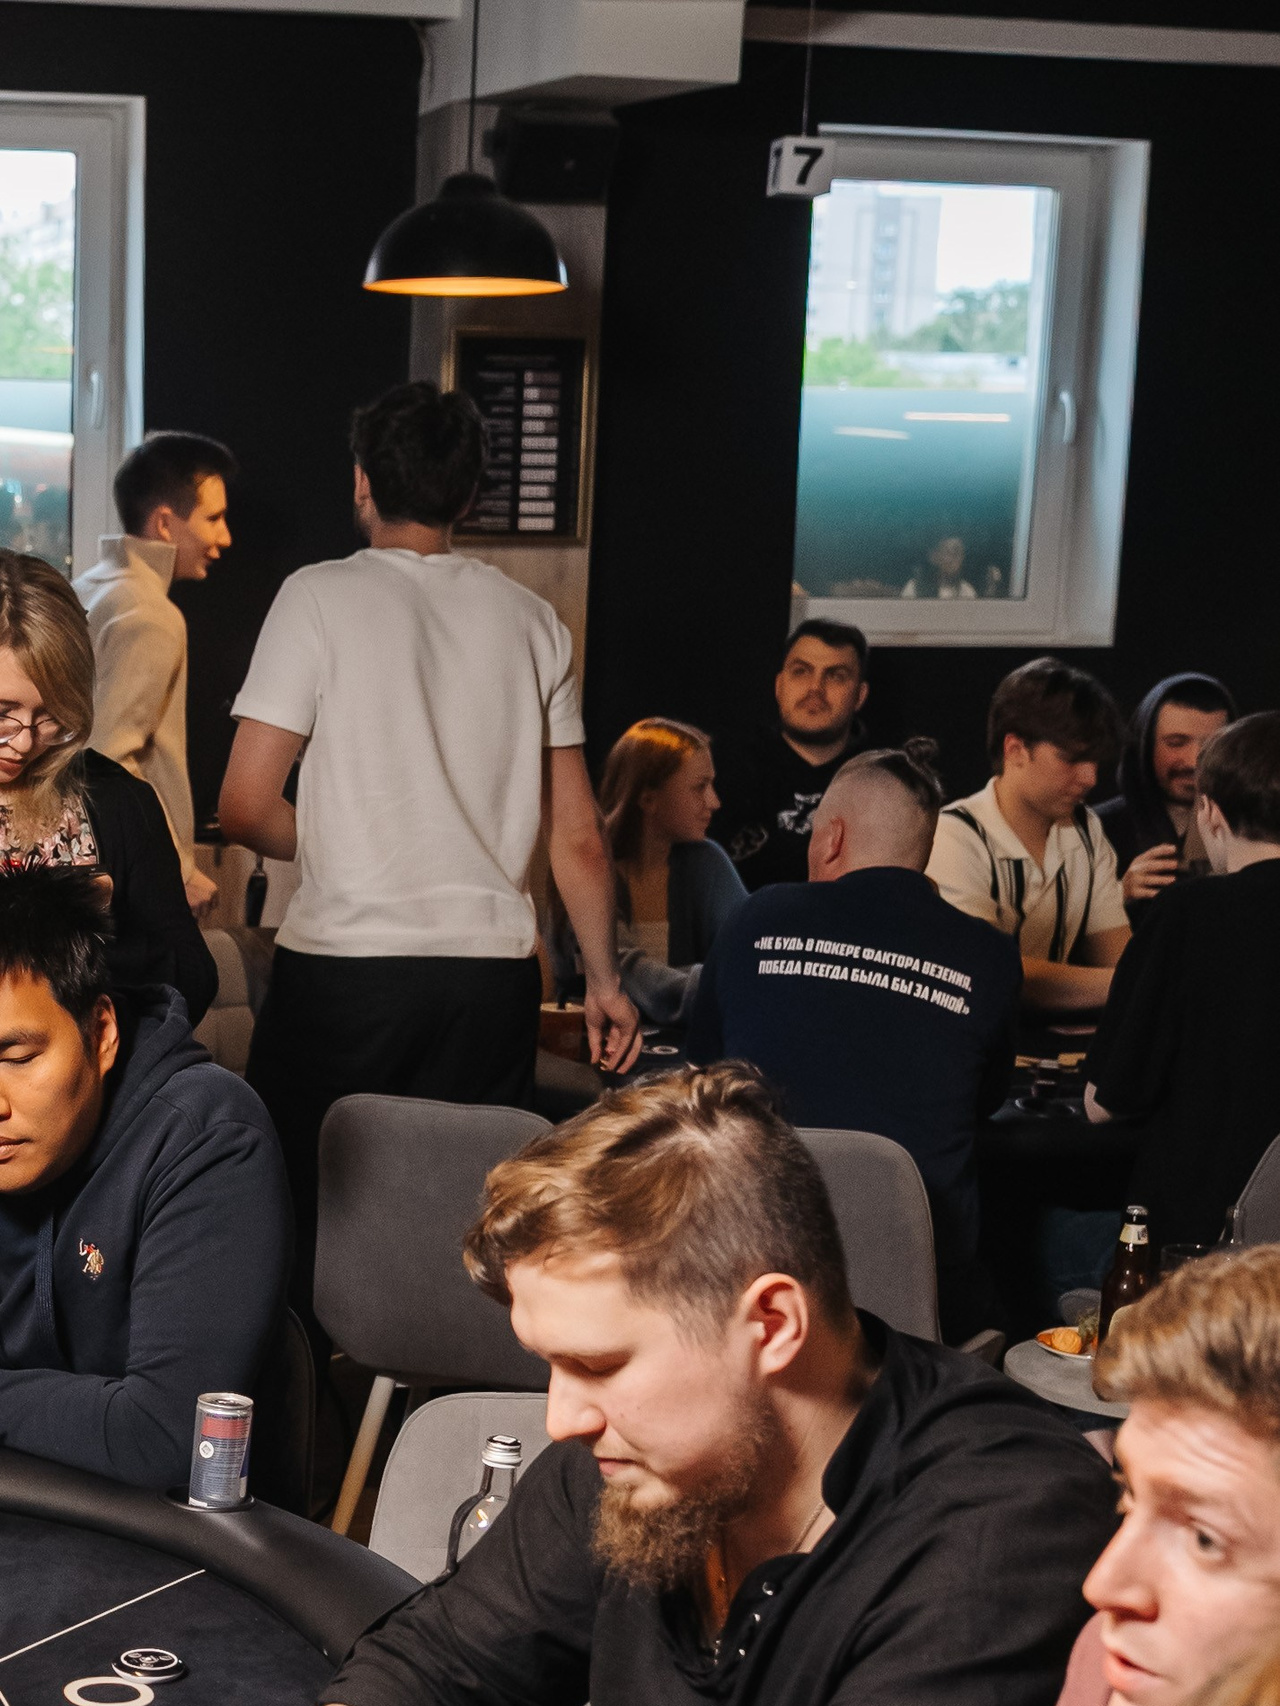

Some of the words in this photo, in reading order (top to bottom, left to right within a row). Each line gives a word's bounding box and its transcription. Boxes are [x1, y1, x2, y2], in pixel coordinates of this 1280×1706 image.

[793, 145, 824, 186] 7
[774, 936, 803, 951] БУДЬ
[805, 938, 814, 952] В
[815, 939, 861, 959] ПОКЕРЕ
[862, 947, 921, 972] ФАКТОРА
[758, 960, 802, 975] ПОБЕДА
[803, 961, 849, 980] ВСЕГДА
[850, 968, 889, 989] БЫЛА
[890, 976, 914, 996] БЫ
[913, 983, 930, 1001] ЗА
